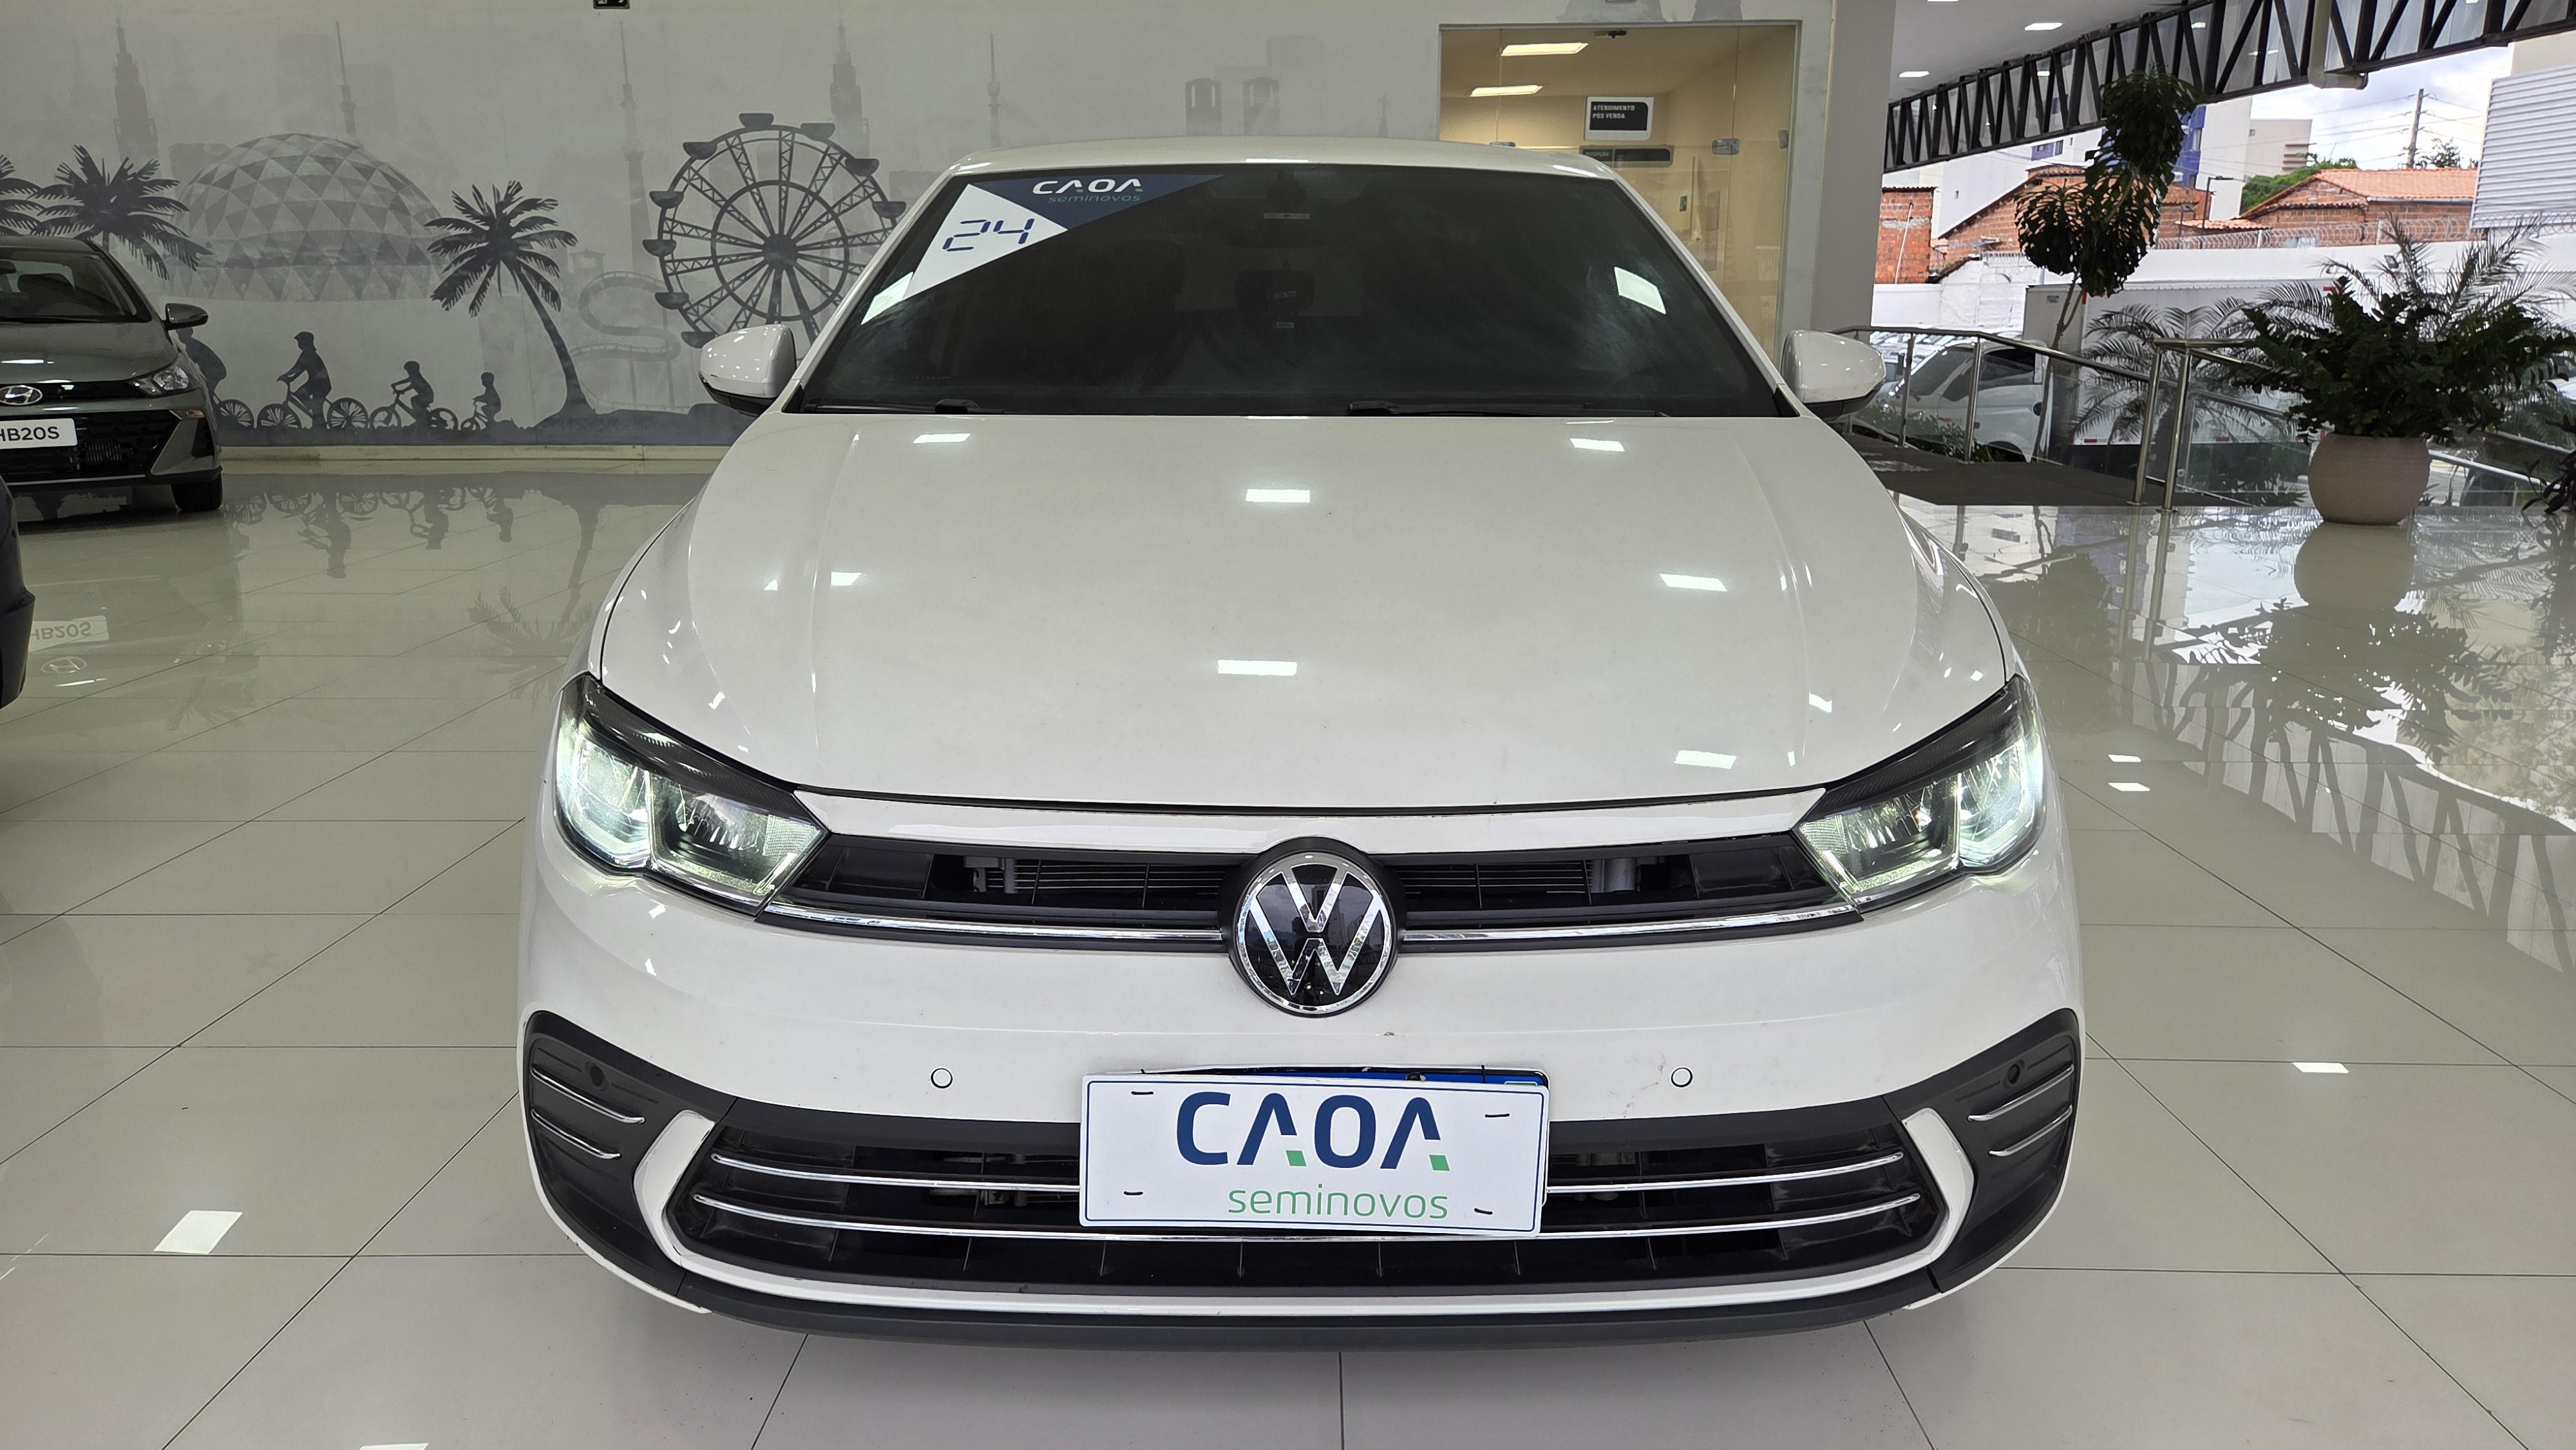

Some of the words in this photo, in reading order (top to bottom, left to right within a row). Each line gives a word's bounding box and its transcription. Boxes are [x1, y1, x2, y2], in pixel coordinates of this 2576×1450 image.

[1032, 178, 1144, 194] CAOA
[1048, 194, 1141, 203] seminovos
[942, 218, 1036, 252] 24
[1176, 1091, 1450, 1172] CAOA
[1227, 1183, 1448, 1219] seminovos
